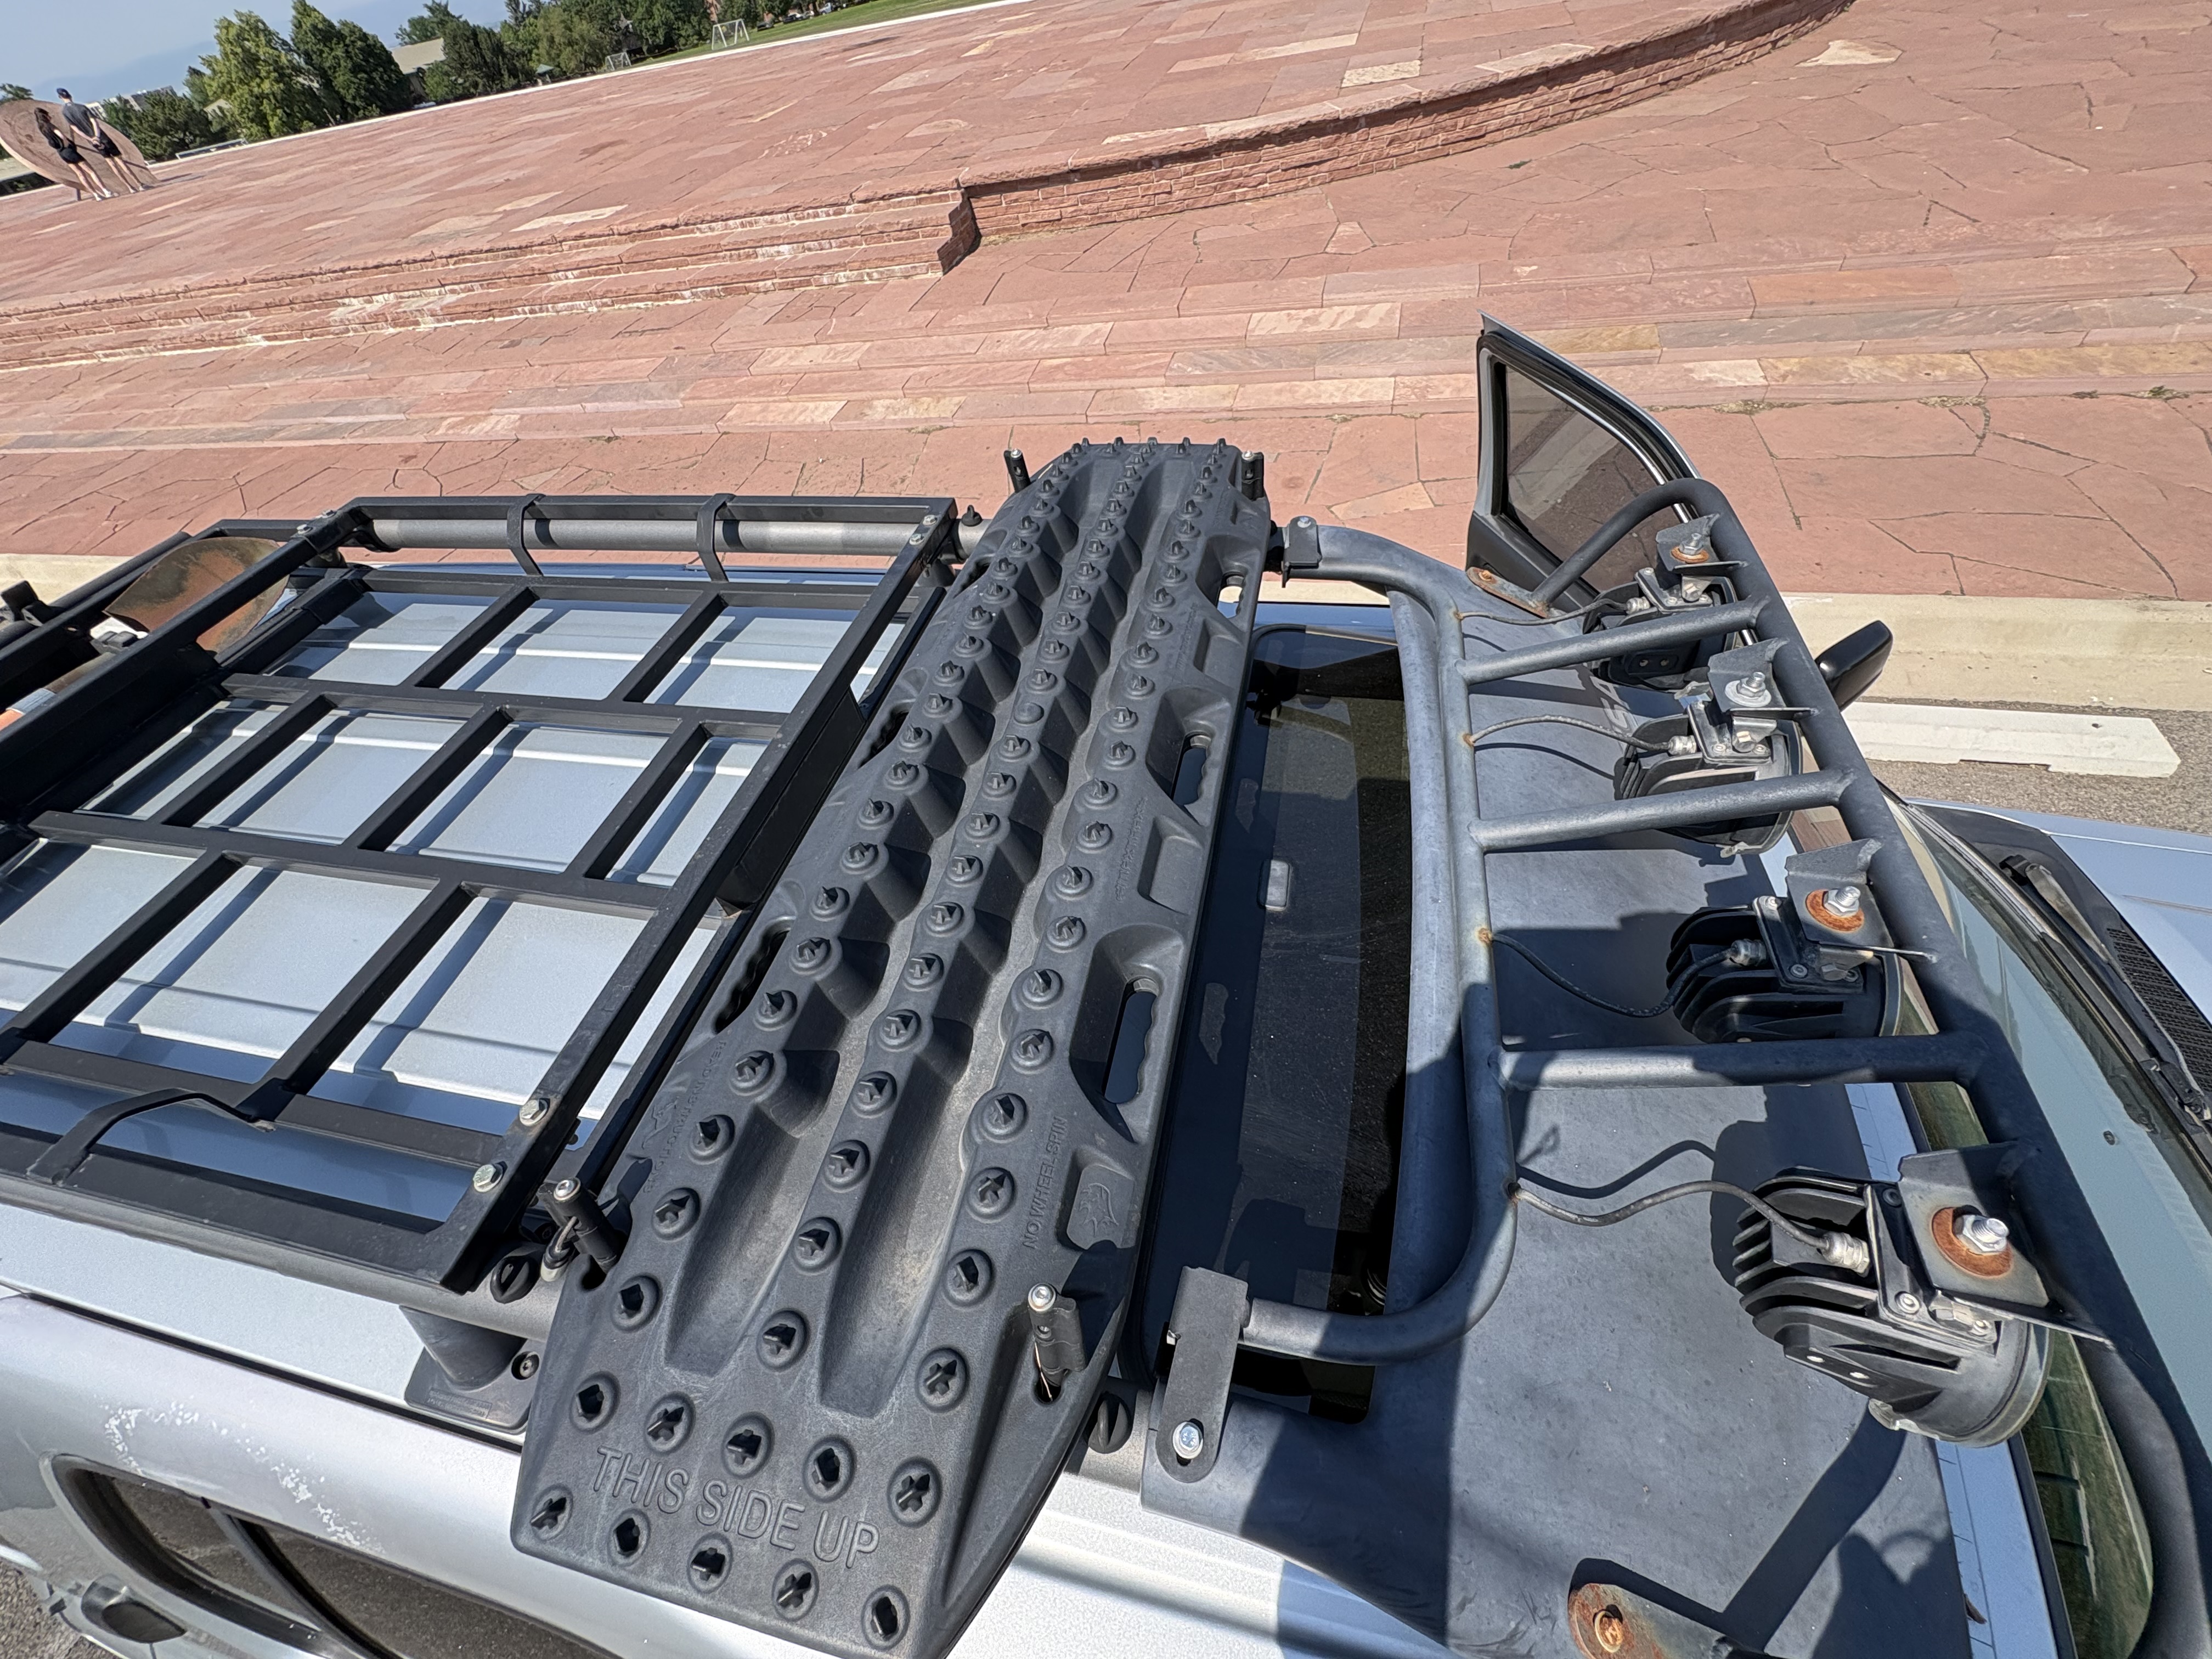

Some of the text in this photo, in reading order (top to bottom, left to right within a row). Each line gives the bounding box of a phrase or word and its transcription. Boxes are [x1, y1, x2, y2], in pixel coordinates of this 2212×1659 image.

[642, 1040, 727, 1194] READ INSTRUCTIONS
[1022, 1115, 1068, 1250] NO WHEEL SPIN
[592, 1445, 881, 1570] THIS SIDE UP
